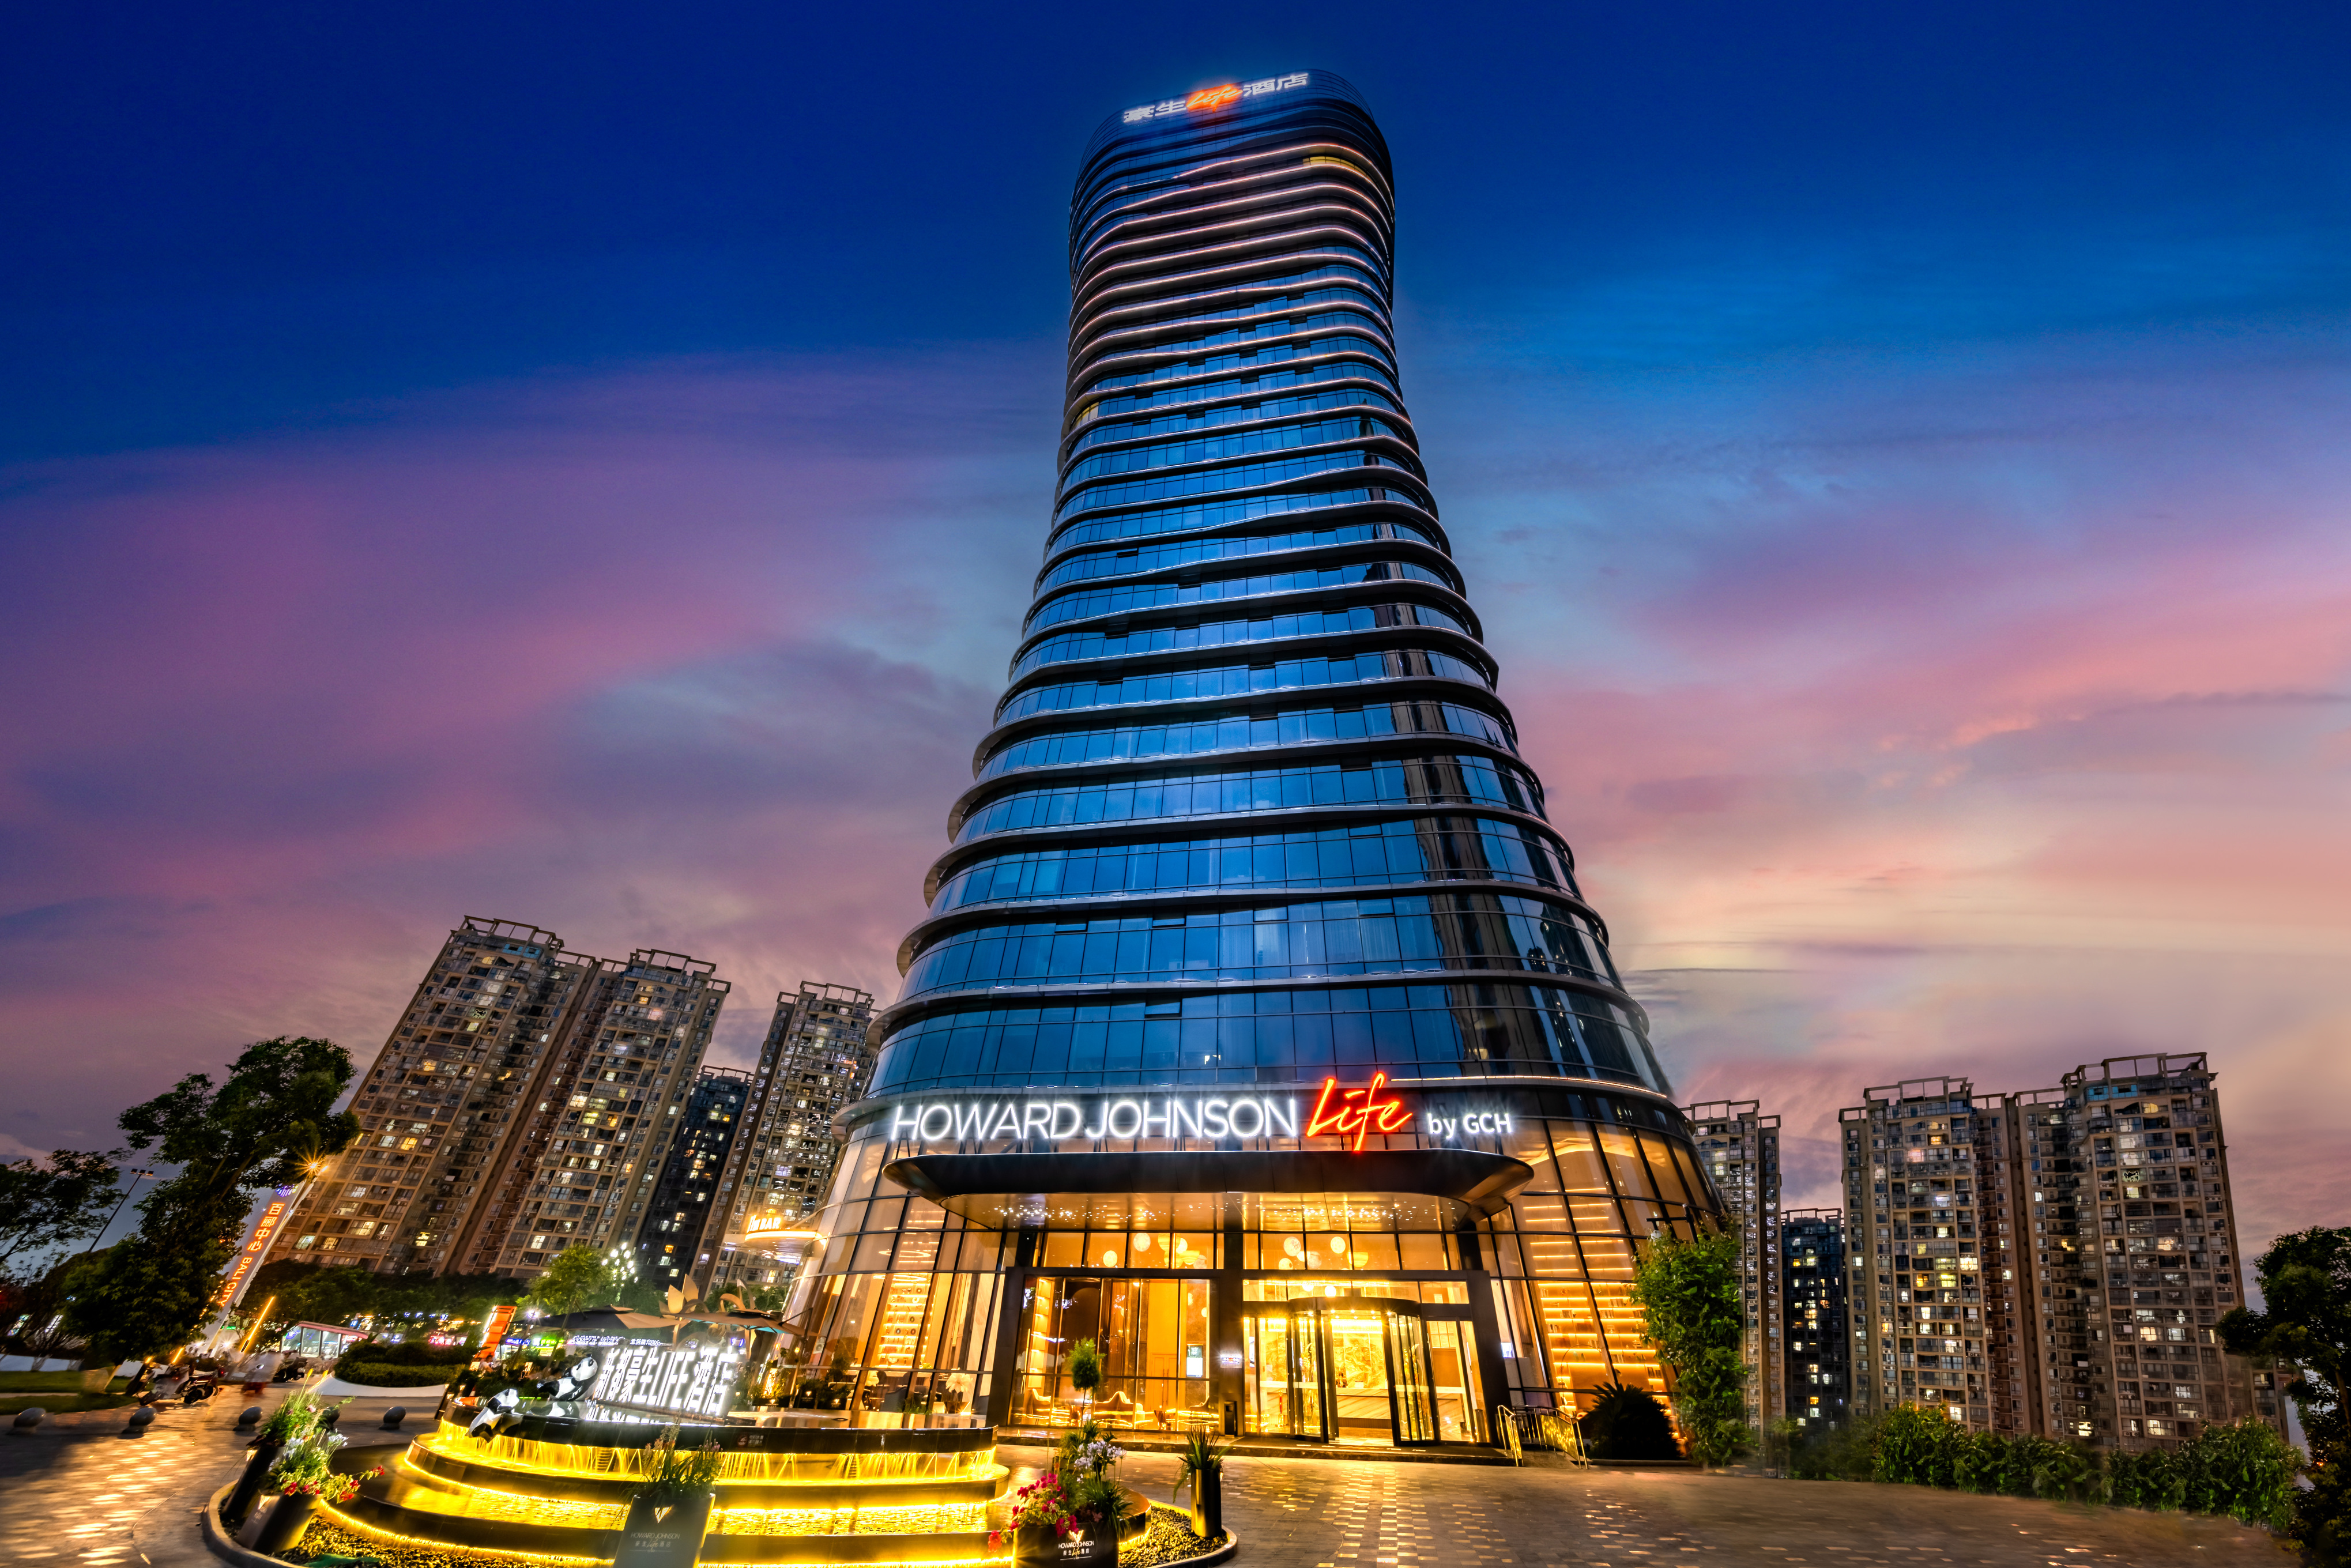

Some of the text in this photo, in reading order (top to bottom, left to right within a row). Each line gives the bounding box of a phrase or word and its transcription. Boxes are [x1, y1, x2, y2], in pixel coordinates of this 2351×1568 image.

[1186, 84, 1244, 113] Life
[1243, 73, 1309, 97] 酒店
[891, 1072, 1513, 1152] HOWARD JOHNSON Life by GCH
[217, 1257, 253, 1307] BALI CITY
